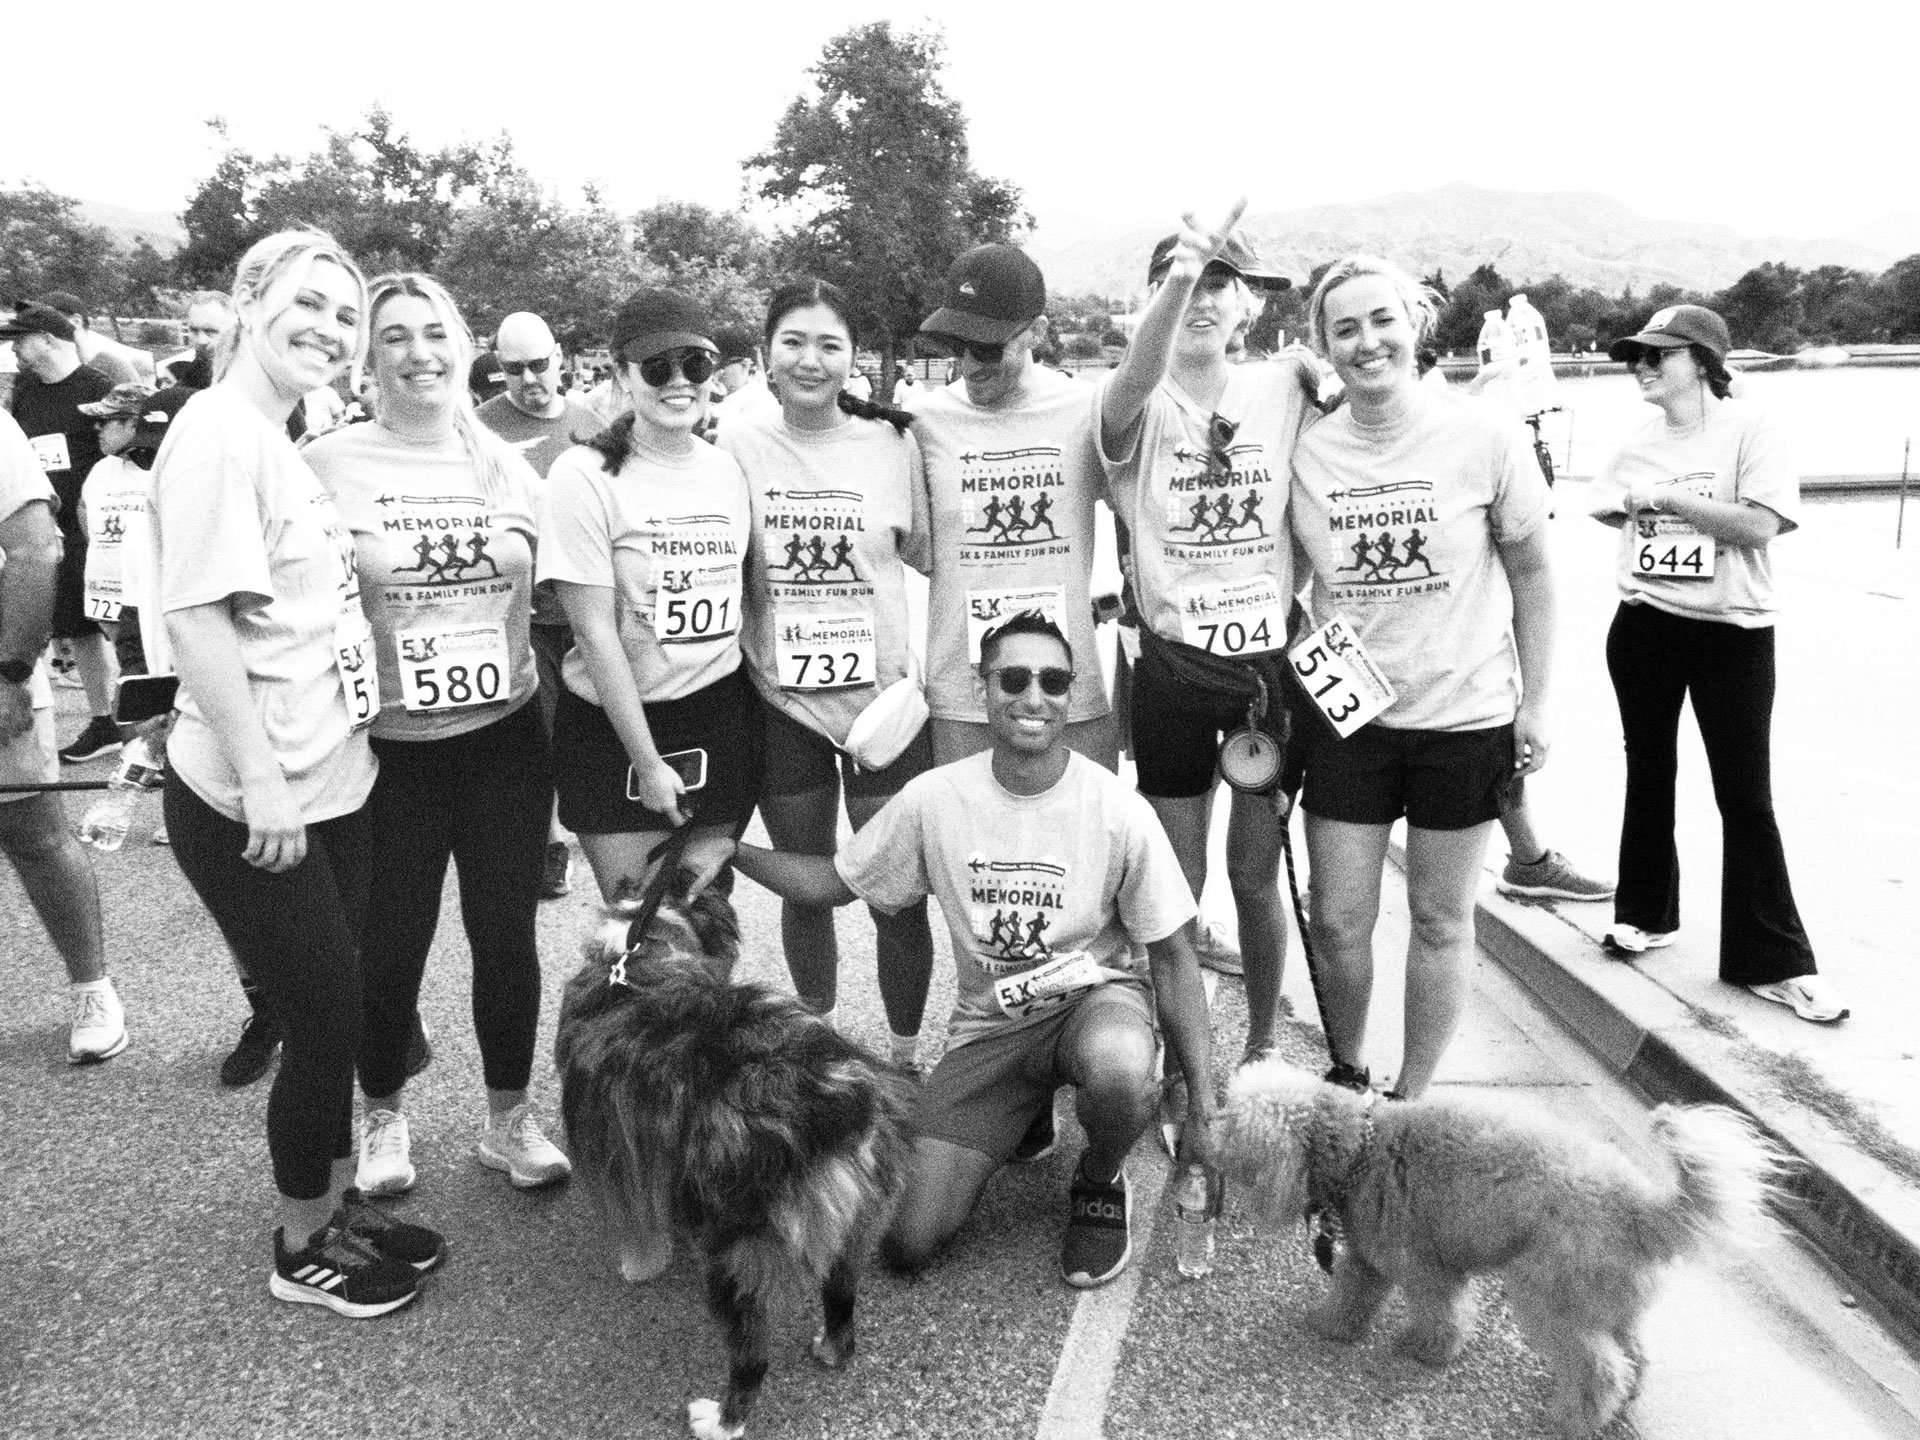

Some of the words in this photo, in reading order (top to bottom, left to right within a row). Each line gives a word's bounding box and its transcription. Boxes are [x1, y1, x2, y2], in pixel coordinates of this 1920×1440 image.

[38, 452, 63, 470] 54
[961, 471, 1065, 493] MEMORIAL
[1169, 468, 1272, 491] MEMORIAL
[383, 514, 493, 532] MEMORIAL
[764, 514, 865, 532] MEMORIAL
[1329, 507, 1438, 531] MEMORIAL
[651, 540, 737, 556] MEMORIAL
[959, 550, 971, 560] 5K
[974, 550, 981, 560] &
[984, 549, 1021, 560] FAMILY
[1024, 547, 1046, 558] FUN
[1049, 545, 1071, 555] RUN
[1163, 546, 1176, 557] 5K
[1188, 549, 1228, 560] FAMILY
[1232, 546, 1254, 557] FUN
[1257, 543, 1275, 553] RUN
[1639, 544, 1703, 574] 644
[384, 591, 401, 602] 5K
[405, 591, 413, 601] &
[416, 588, 459, 601] FAMILY
[463, 585, 487, 597] FUN
[490, 582, 513, 594] RUN
[662, 570, 692, 592] 5K
[773, 588, 780, 597] &
[784, 588, 822, 597] FAMILY
[825, 587, 848, 597] FUN
[851, 587, 874, 597] RUN
[1329, 590, 1343, 600] 5K
[1346, 589, 1353, 598] &
[1355, 588, 1392, 598] FAMILY
[1396, 585, 1422, 597] FUN
[1425, 580, 1450, 592] RUN
[971, 598, 1001, 619] 5K
[1217, 591, 1277, 608] MEMORIAL
[665, 597, 729, 636] 501
[812, 628, 872, 640] MEMORIAL
[1197, 617, 1271, 653] 704
[1323, 622, 1353, 657] 5K
[402, 637, 438, 660] 5K
[791, 652, 862, 685] 732
[414, 663, 500, 707] 580
[1294, 645, 1360, 723] 513
[971, 887, 1064, 910] MEMORIAL
[1001, 981, 1035, 1007] 5K
